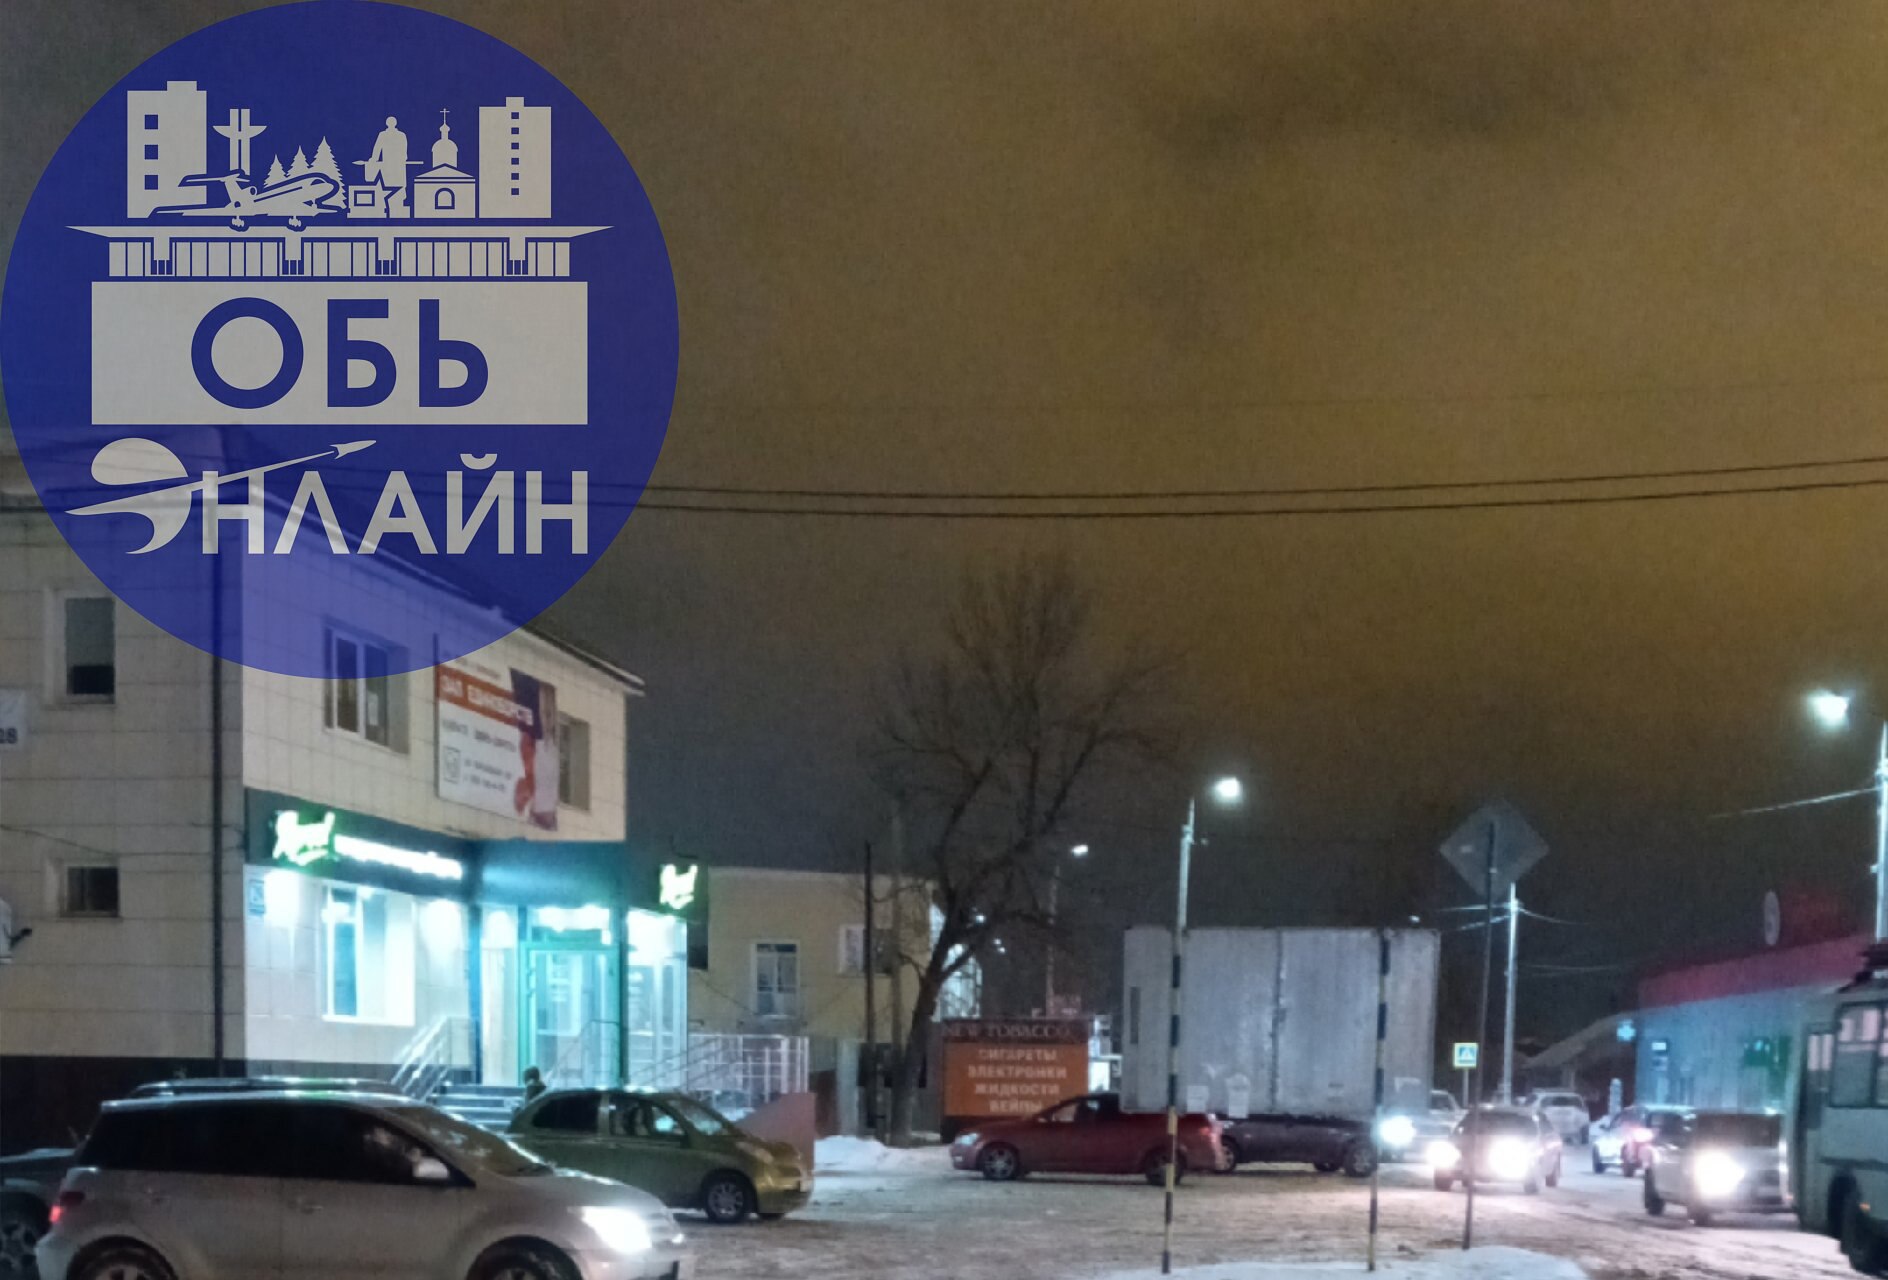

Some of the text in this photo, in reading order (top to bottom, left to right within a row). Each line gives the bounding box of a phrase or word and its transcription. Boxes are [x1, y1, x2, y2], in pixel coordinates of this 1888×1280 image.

[979, 1048, 1057, 1061] СИГАРЕТЫ
[968, 1065, 1067, 1079] ЭЛЕКТРОНКИ
[975, 1083, 1061, 1097] ЖИДКОСТИ
[989, 1098, 1043, 1113] ВЕЙПЫ
